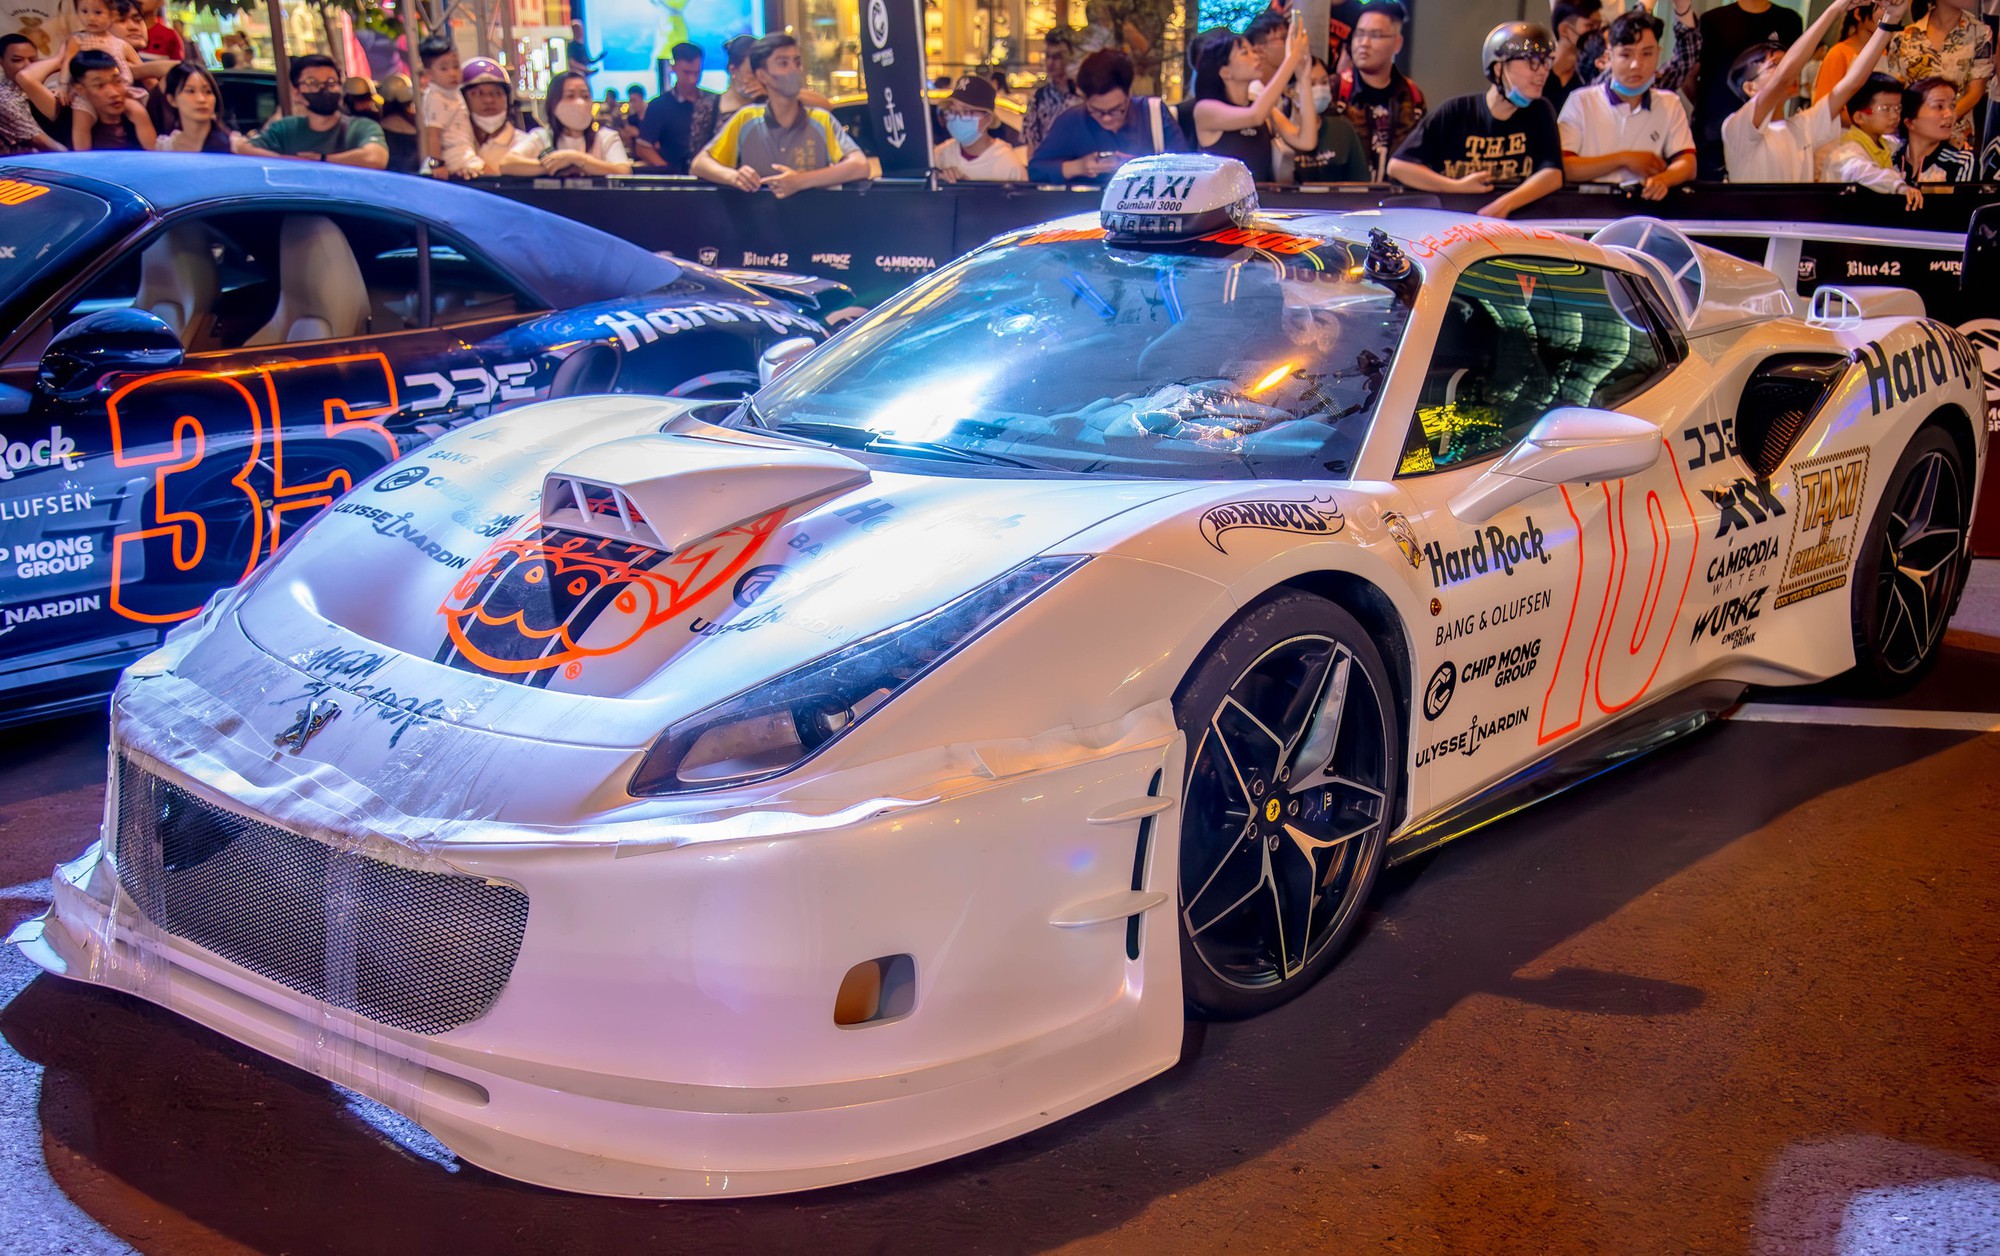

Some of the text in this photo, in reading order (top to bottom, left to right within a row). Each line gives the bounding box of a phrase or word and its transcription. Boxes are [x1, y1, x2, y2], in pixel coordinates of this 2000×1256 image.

[1465, 132, 1527, 158] THE
[1123, 175, 1196, 200] TAXI
[1117, 201, 1182, 212] Gumball 3000
[875, 255, 936, 269] CAMBODIA
[594, 302, 740, 352] Hard
[1856, 319, 1948, 417] Hard
[1801, 460, 1862, 532] TAXI
[15, 535, 93, 563] MONG
[334, 502, 472, 570] ULYSSE NARDIN
[17, 553, 94, 579] GROUP
[1424, 530, 1488, 588] Hard
[1707, 535, 1779, 583] CAMBODIA
[1789, 535, 1847, 579] GUMBALL
[1712, 565, 1767, 596] WATER
[5, 595, 101, 625] NARDIN
[1435, 589, 1552, 647] BANG & OLUFSEN
[1689, 585, 1770, 647] WURKZ
[1721, 624, 1751, 646] ENERGY
[1732, 632, 1757, 650] DRINK
[1461, 638, 1542, 684] CHIP MONG
[1494, 659, 1537, 688] GROUP
[1415, 706, 1530, 768] ULYSSE NARDIN
